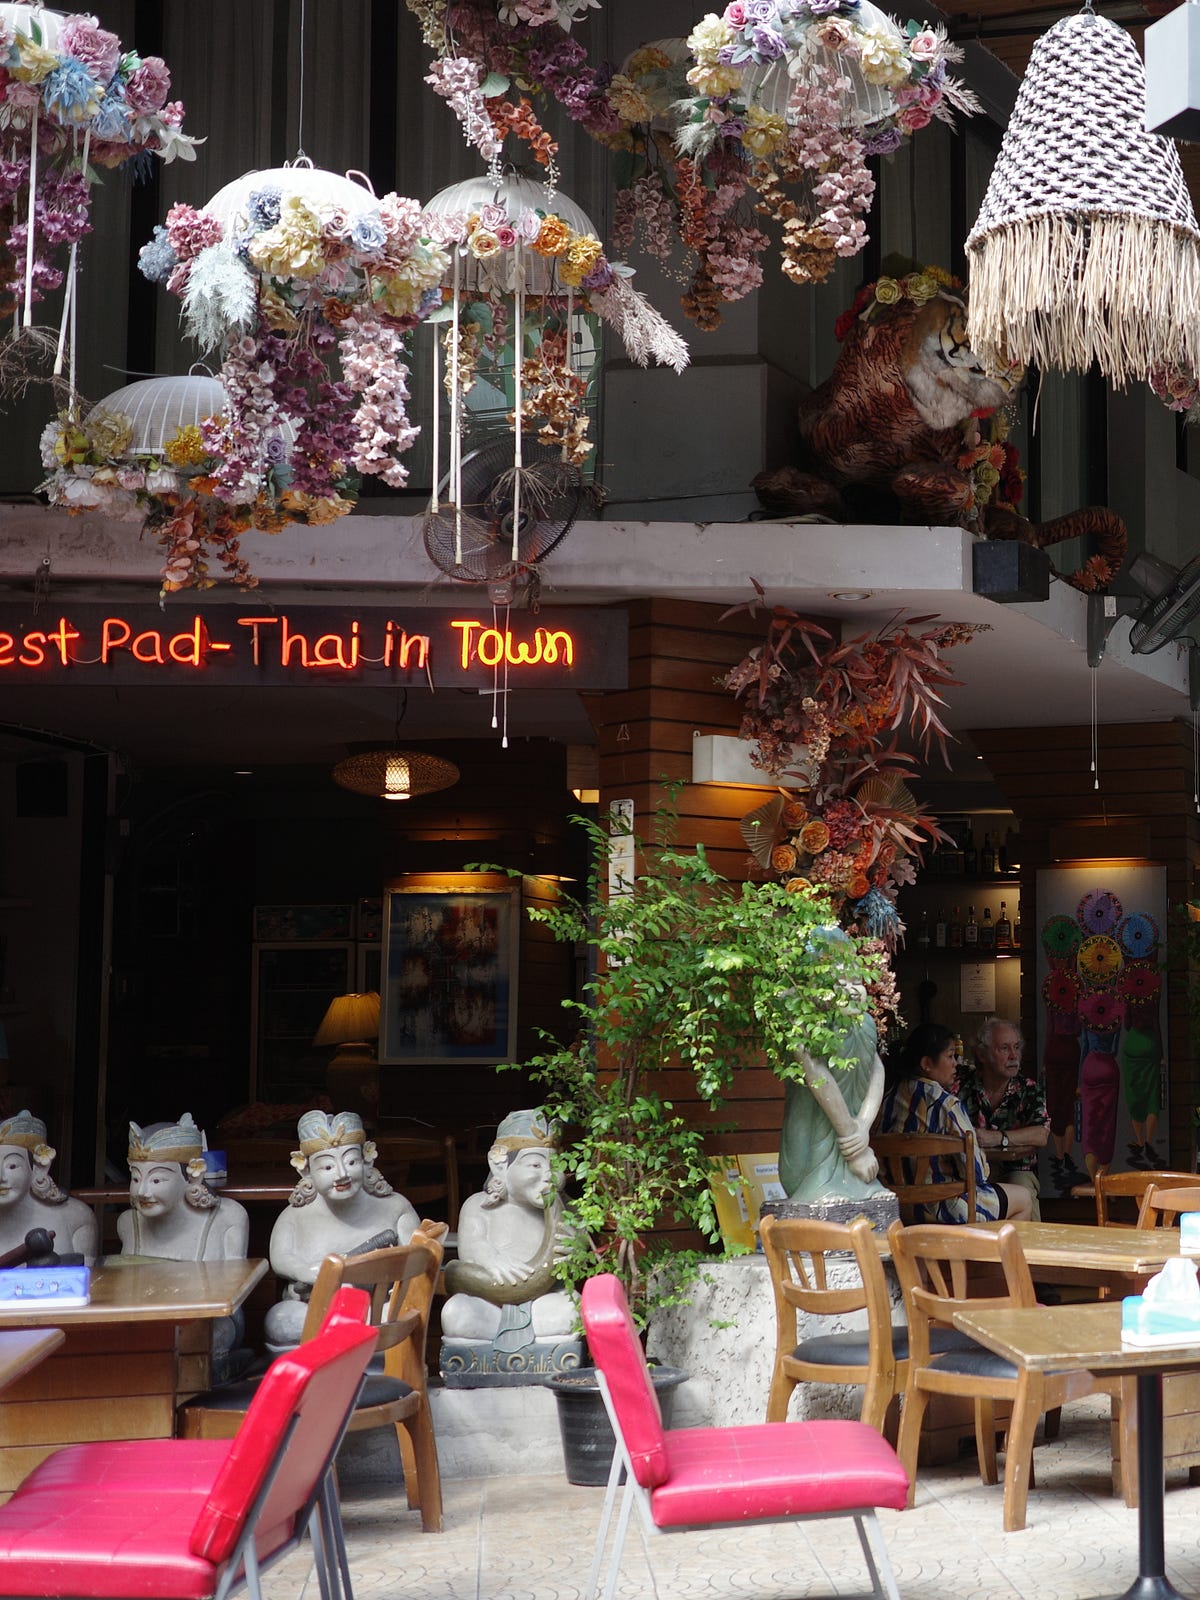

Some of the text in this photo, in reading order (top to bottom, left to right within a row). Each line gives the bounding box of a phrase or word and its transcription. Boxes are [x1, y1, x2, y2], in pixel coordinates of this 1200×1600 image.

[102, 615, 360, 668] Pad-Thai
[384, 620, 429, 669] in
[450, 620, 574, 669] Town
